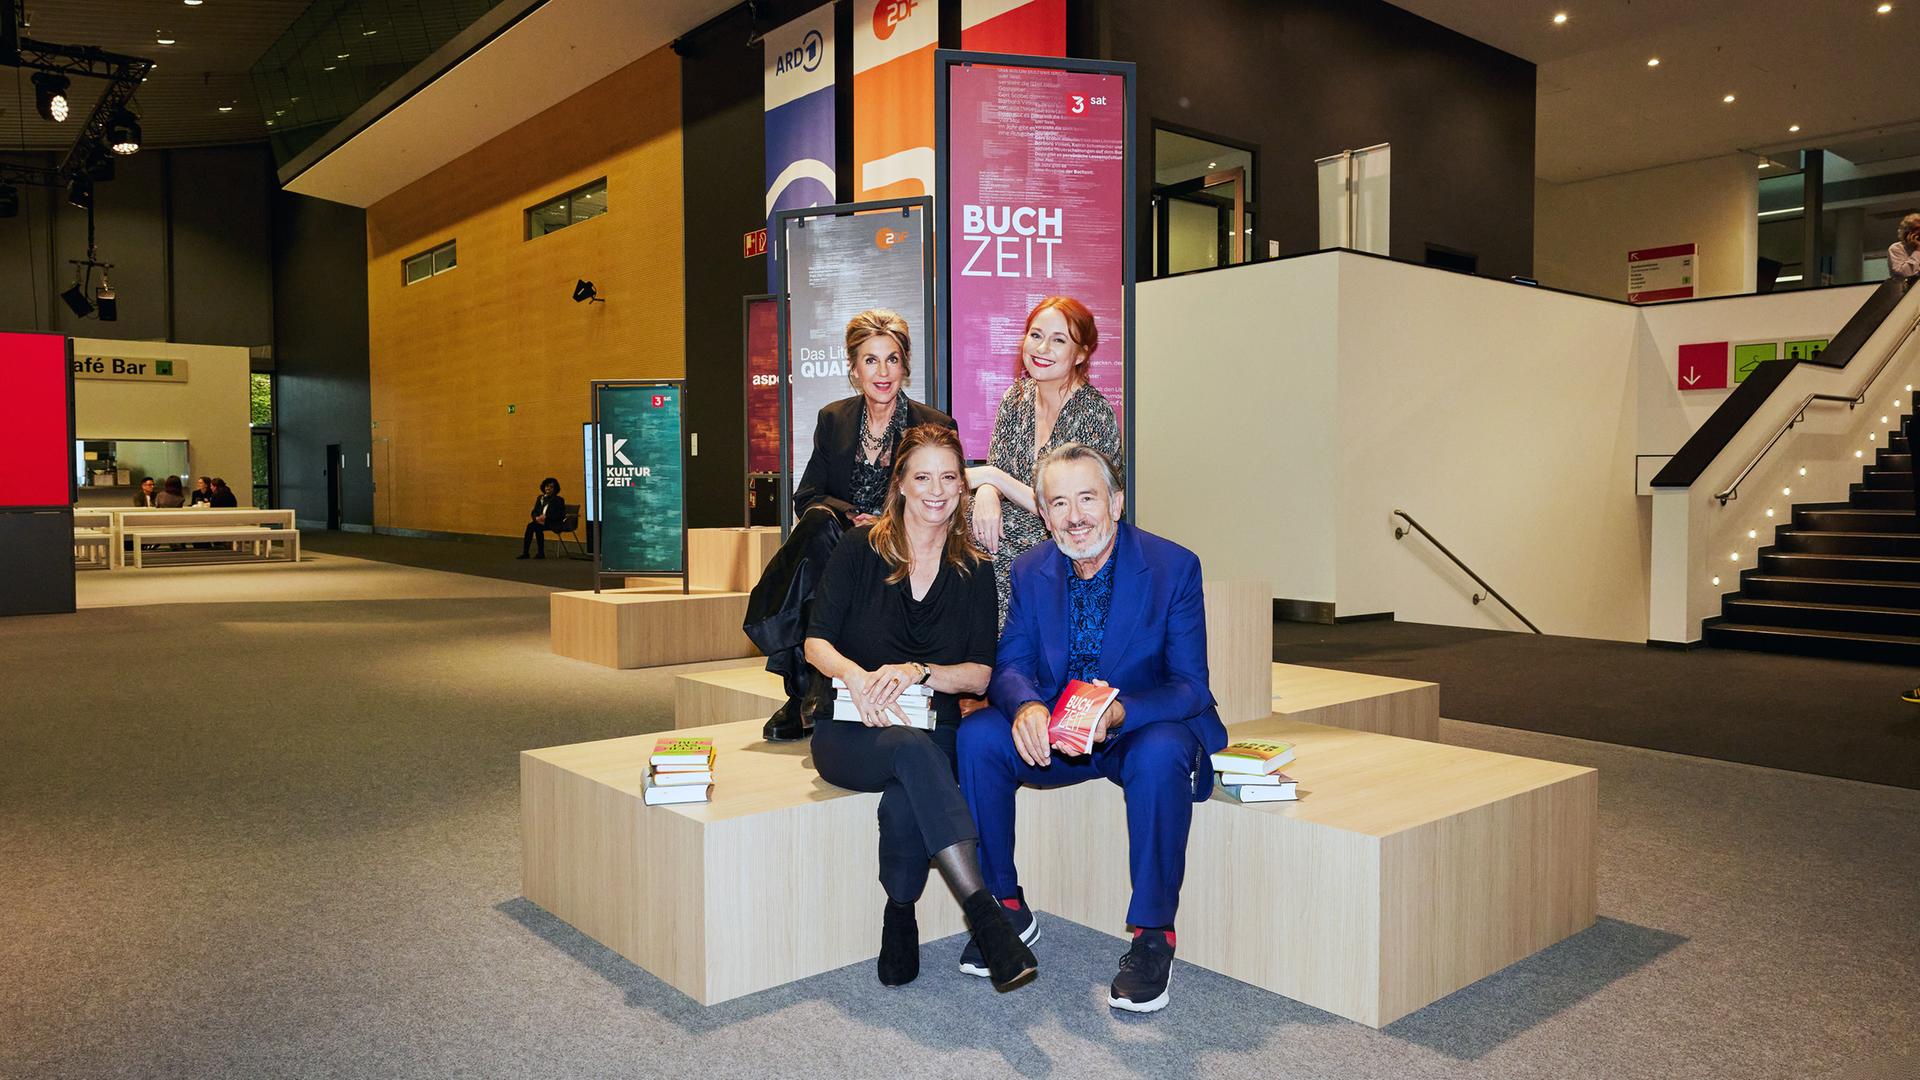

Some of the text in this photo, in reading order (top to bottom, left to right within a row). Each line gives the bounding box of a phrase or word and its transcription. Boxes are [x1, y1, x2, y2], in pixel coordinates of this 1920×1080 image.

[776, 47, 803, 76] ARD
[963, 204, 1062, 237] BUCH
[961, 235, 1062, 278] ZEIT
[800, 347, 826, 361] Das
[74, 357, 146, 375] afé Bar
[606, 466, 651, 477] KULTUR
[1066, 694, 1094, 712] BUCH
[1058, 708, 1087, 732] ZEIT
